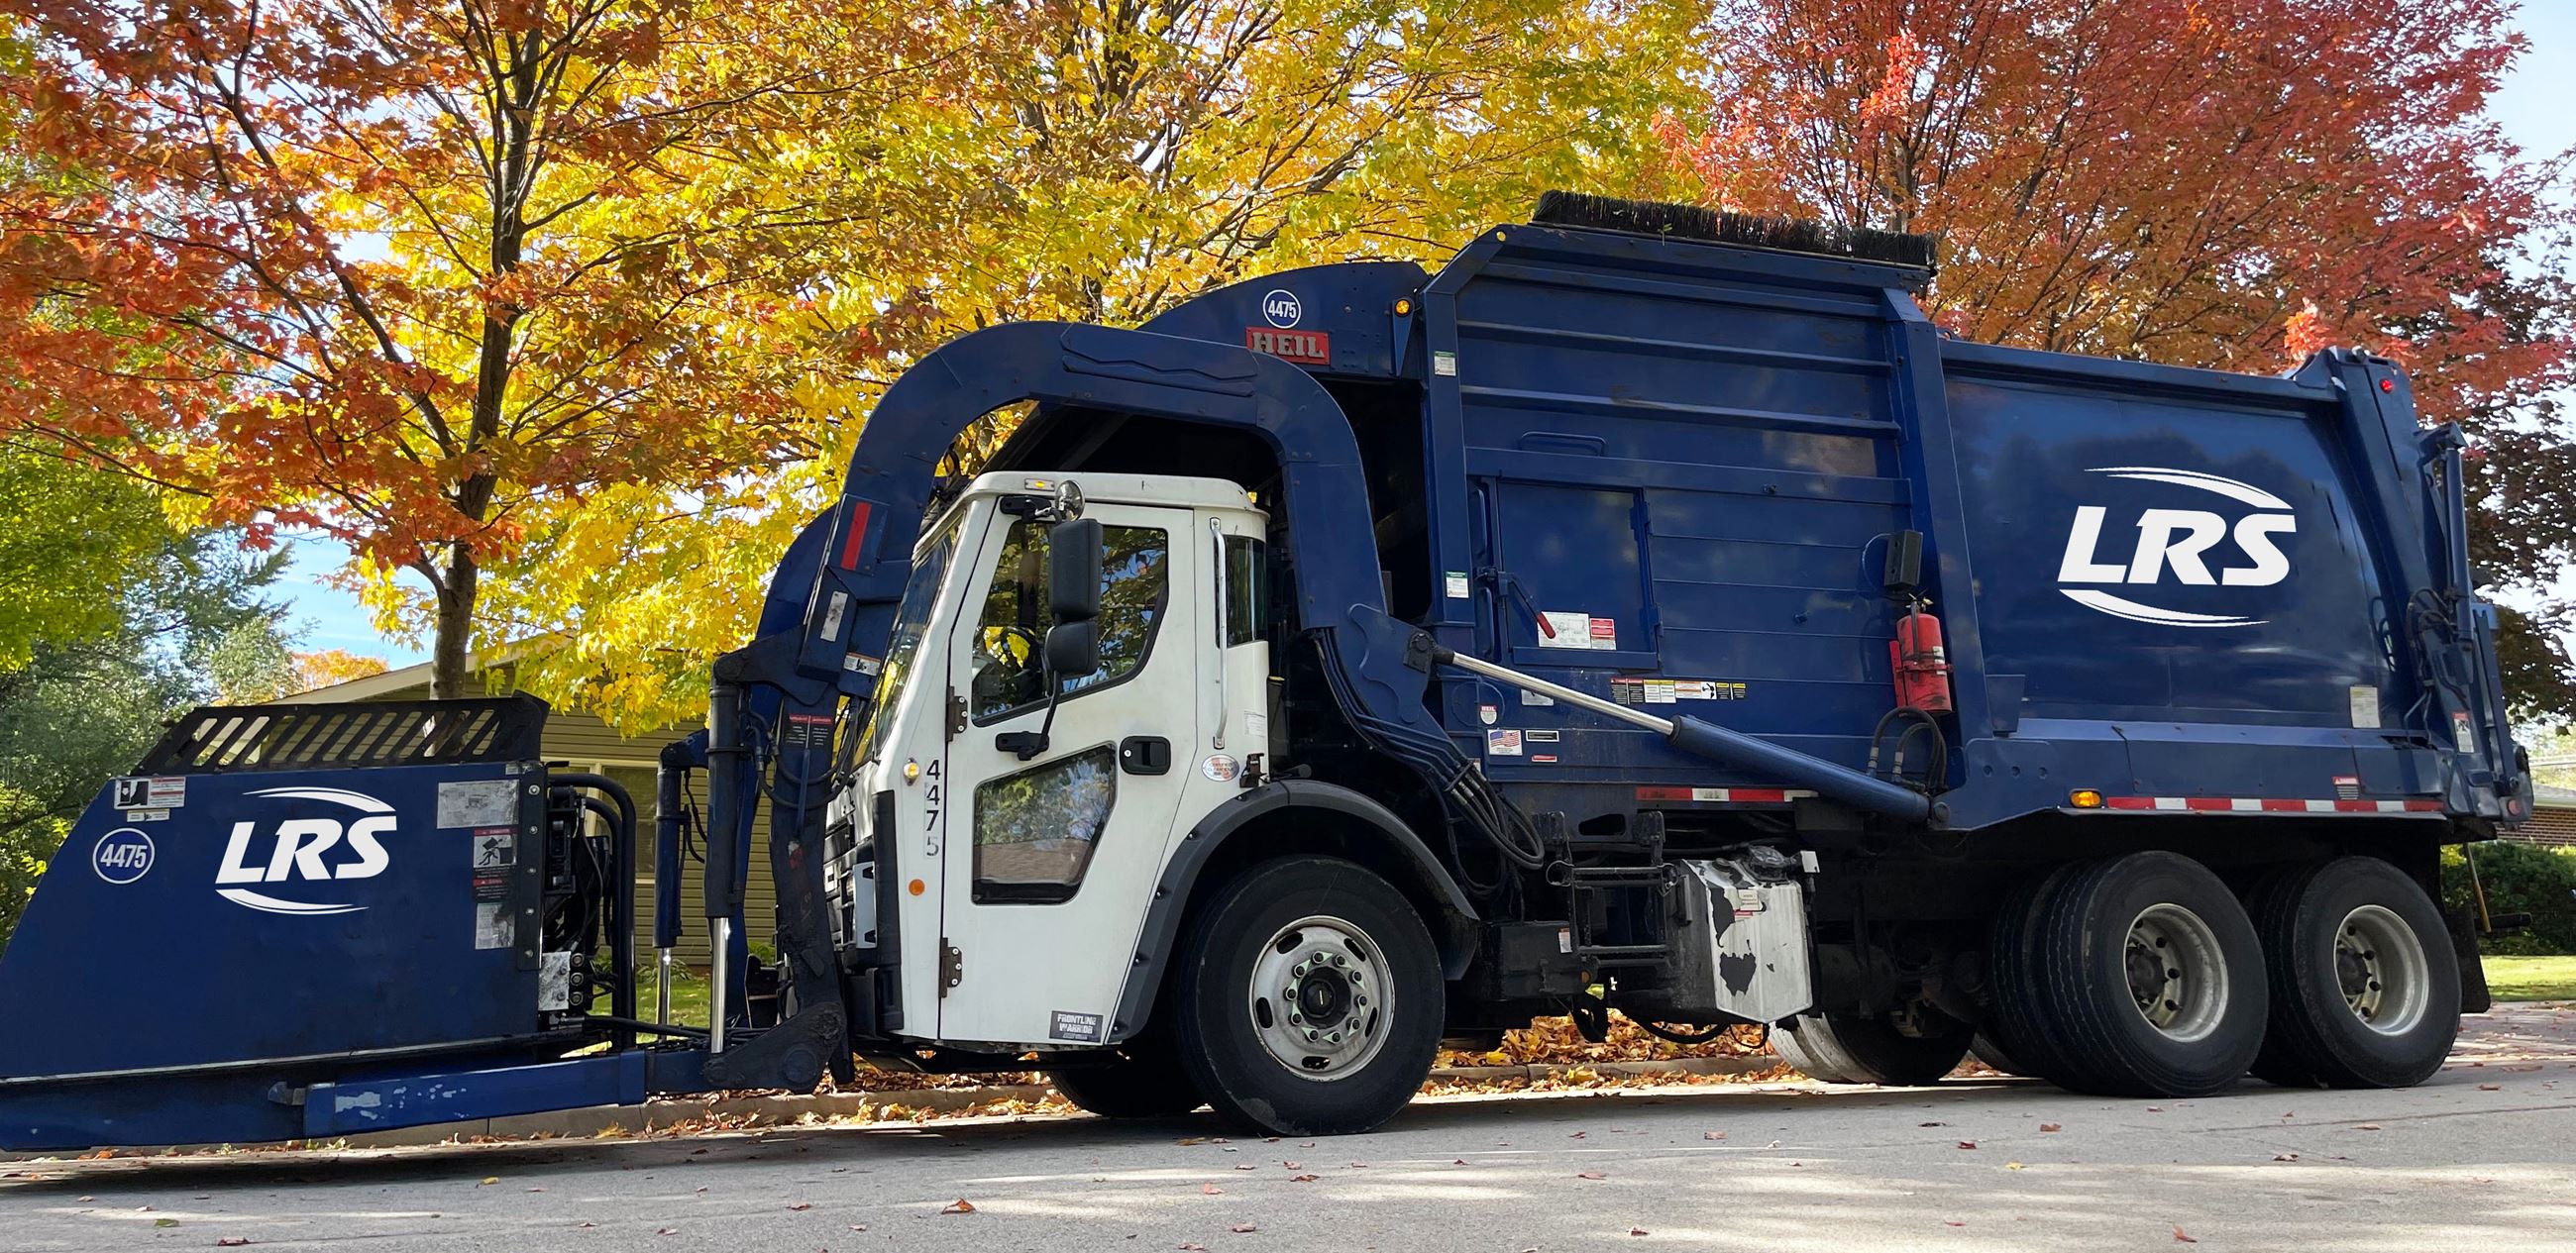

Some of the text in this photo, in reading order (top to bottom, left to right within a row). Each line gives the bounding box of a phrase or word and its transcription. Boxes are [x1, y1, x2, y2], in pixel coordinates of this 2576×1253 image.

[1268, 299, 1297, 319] 4475
[1252, 332, 1325, 359] HEIL
[2057, 505, 2297, 586] LRS
[925, 759, 940, 857] 4475
[100, 843, 148, 868] 4475
[215, 815, 397, 885] LRS
[1057, 1013, 1097, 1026] FRONTLINE
